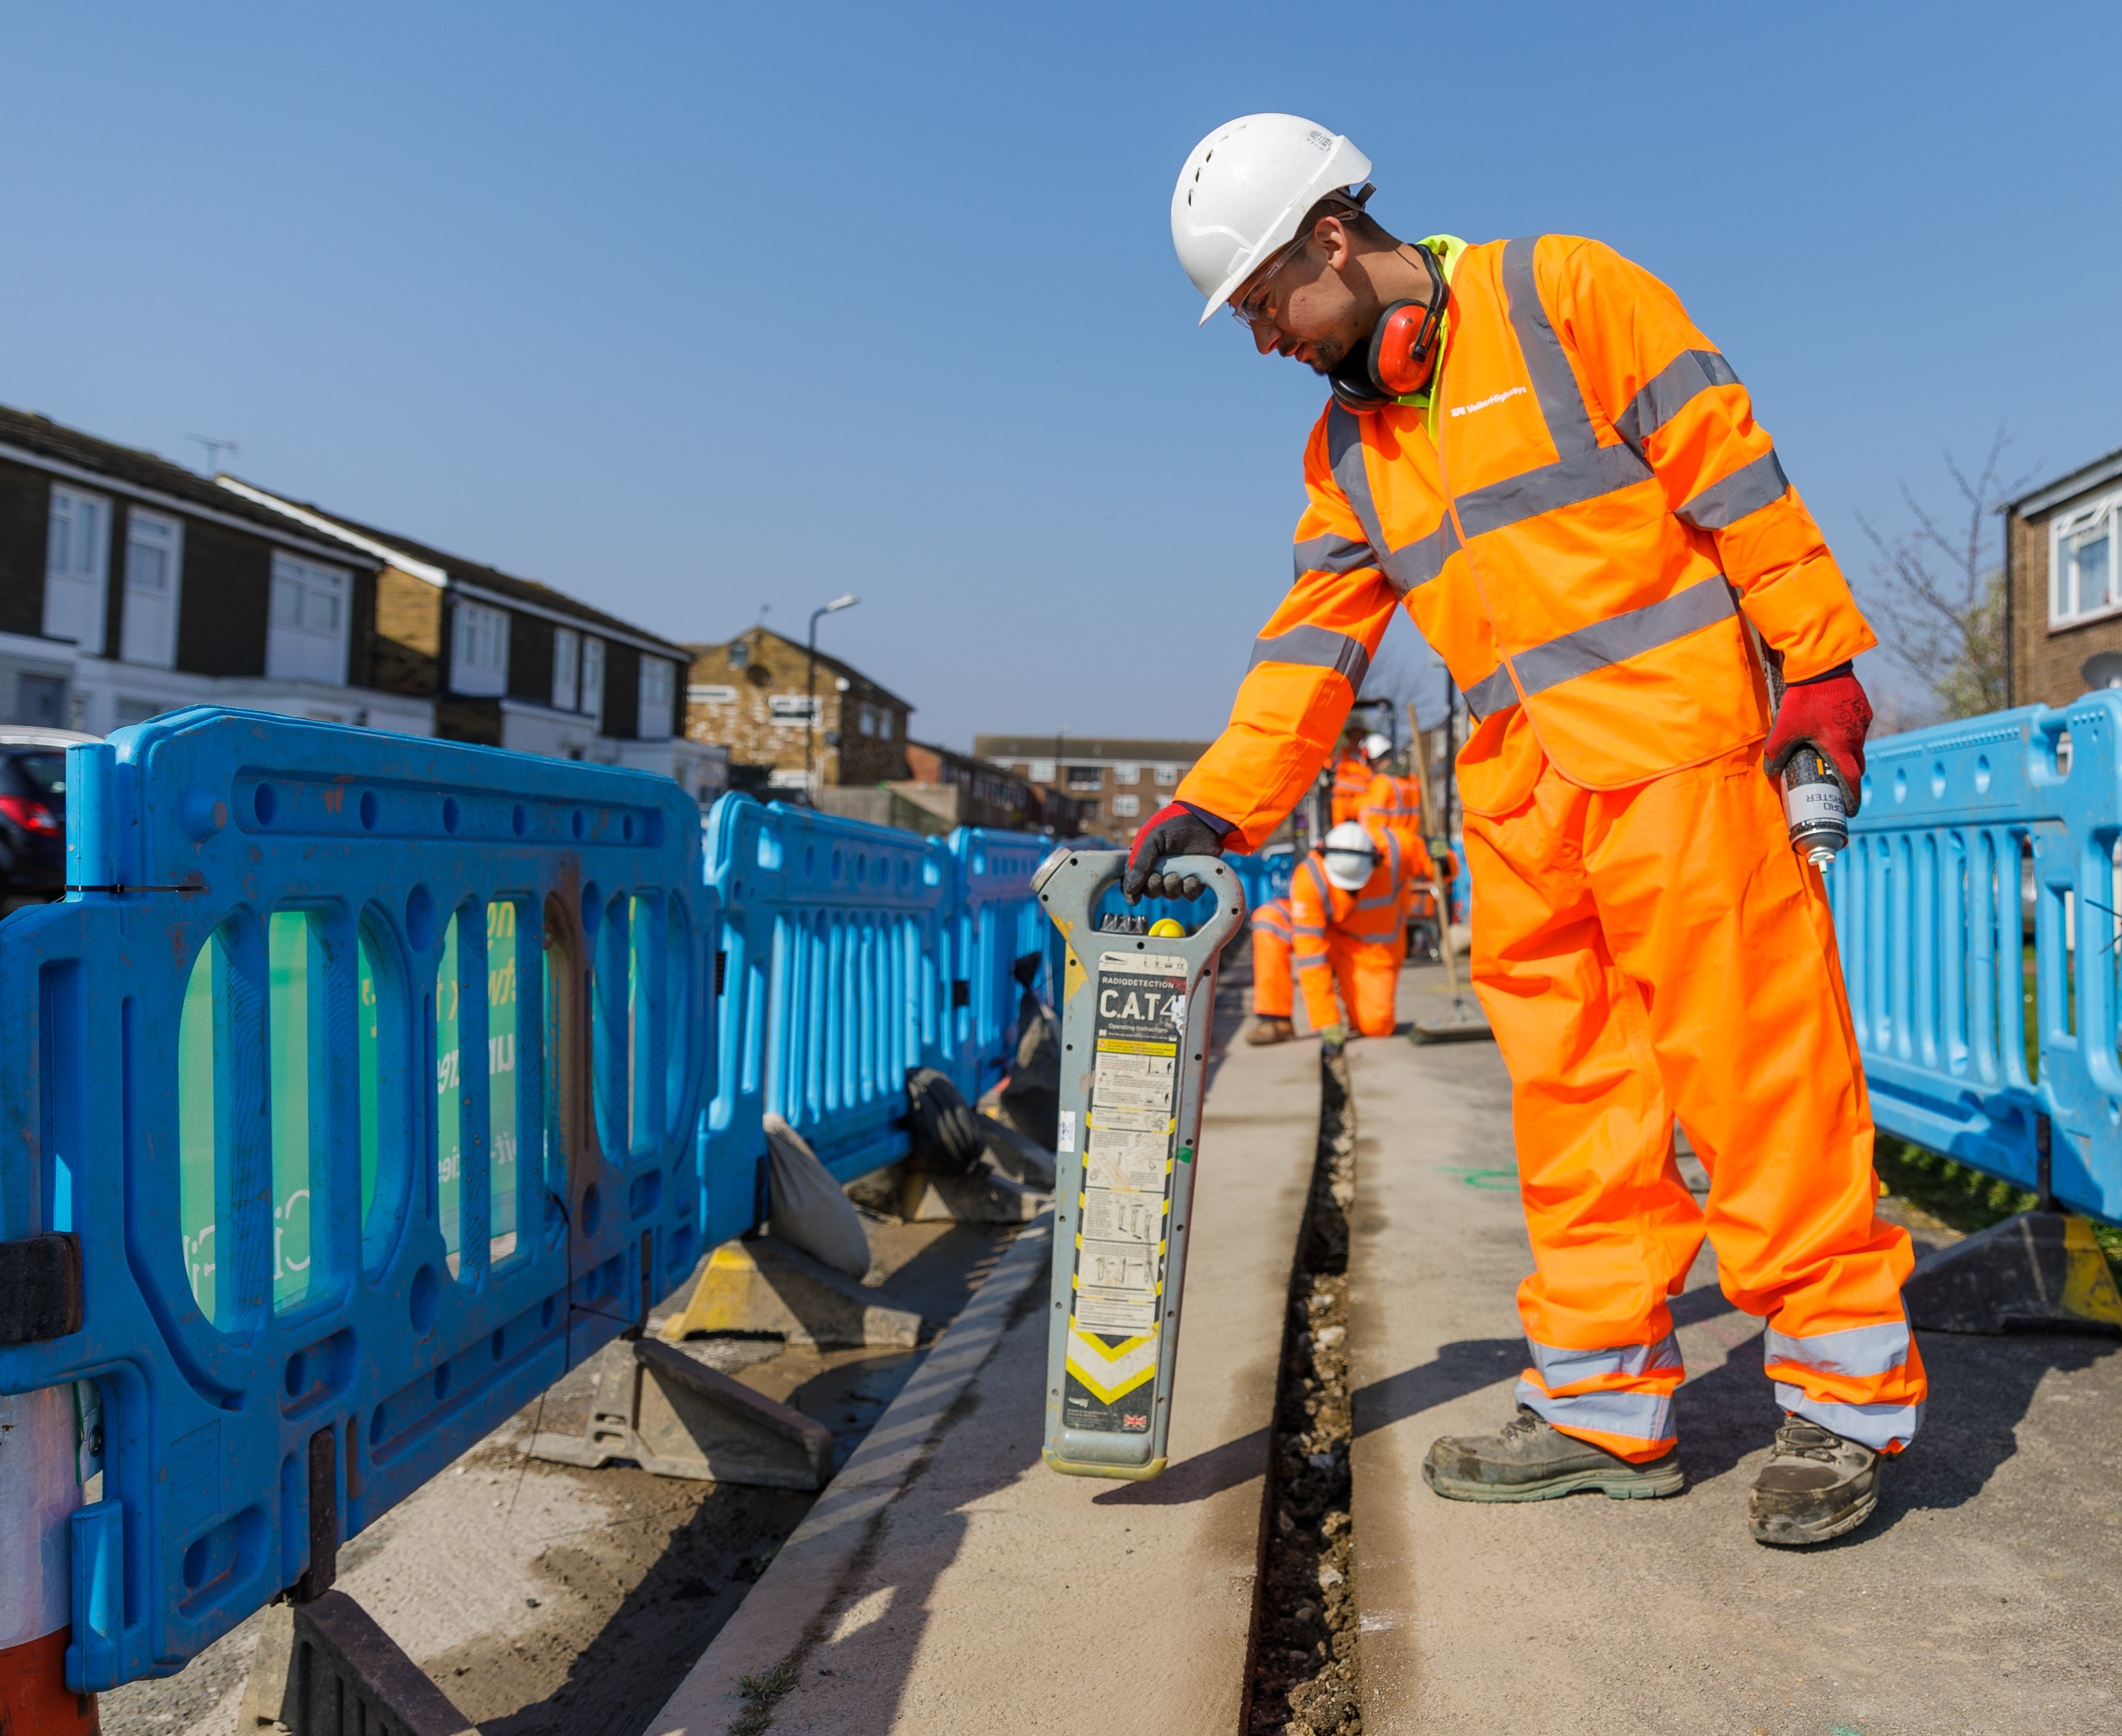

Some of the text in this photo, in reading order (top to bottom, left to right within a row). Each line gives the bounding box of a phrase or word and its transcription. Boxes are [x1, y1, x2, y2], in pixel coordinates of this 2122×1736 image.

[1466, 386, 1527, 413] VolkerHighways
[1102, 976, 1174, 989] RADIODETECTION
[1108, 1023, 1168, 1034] Operating Instructions
